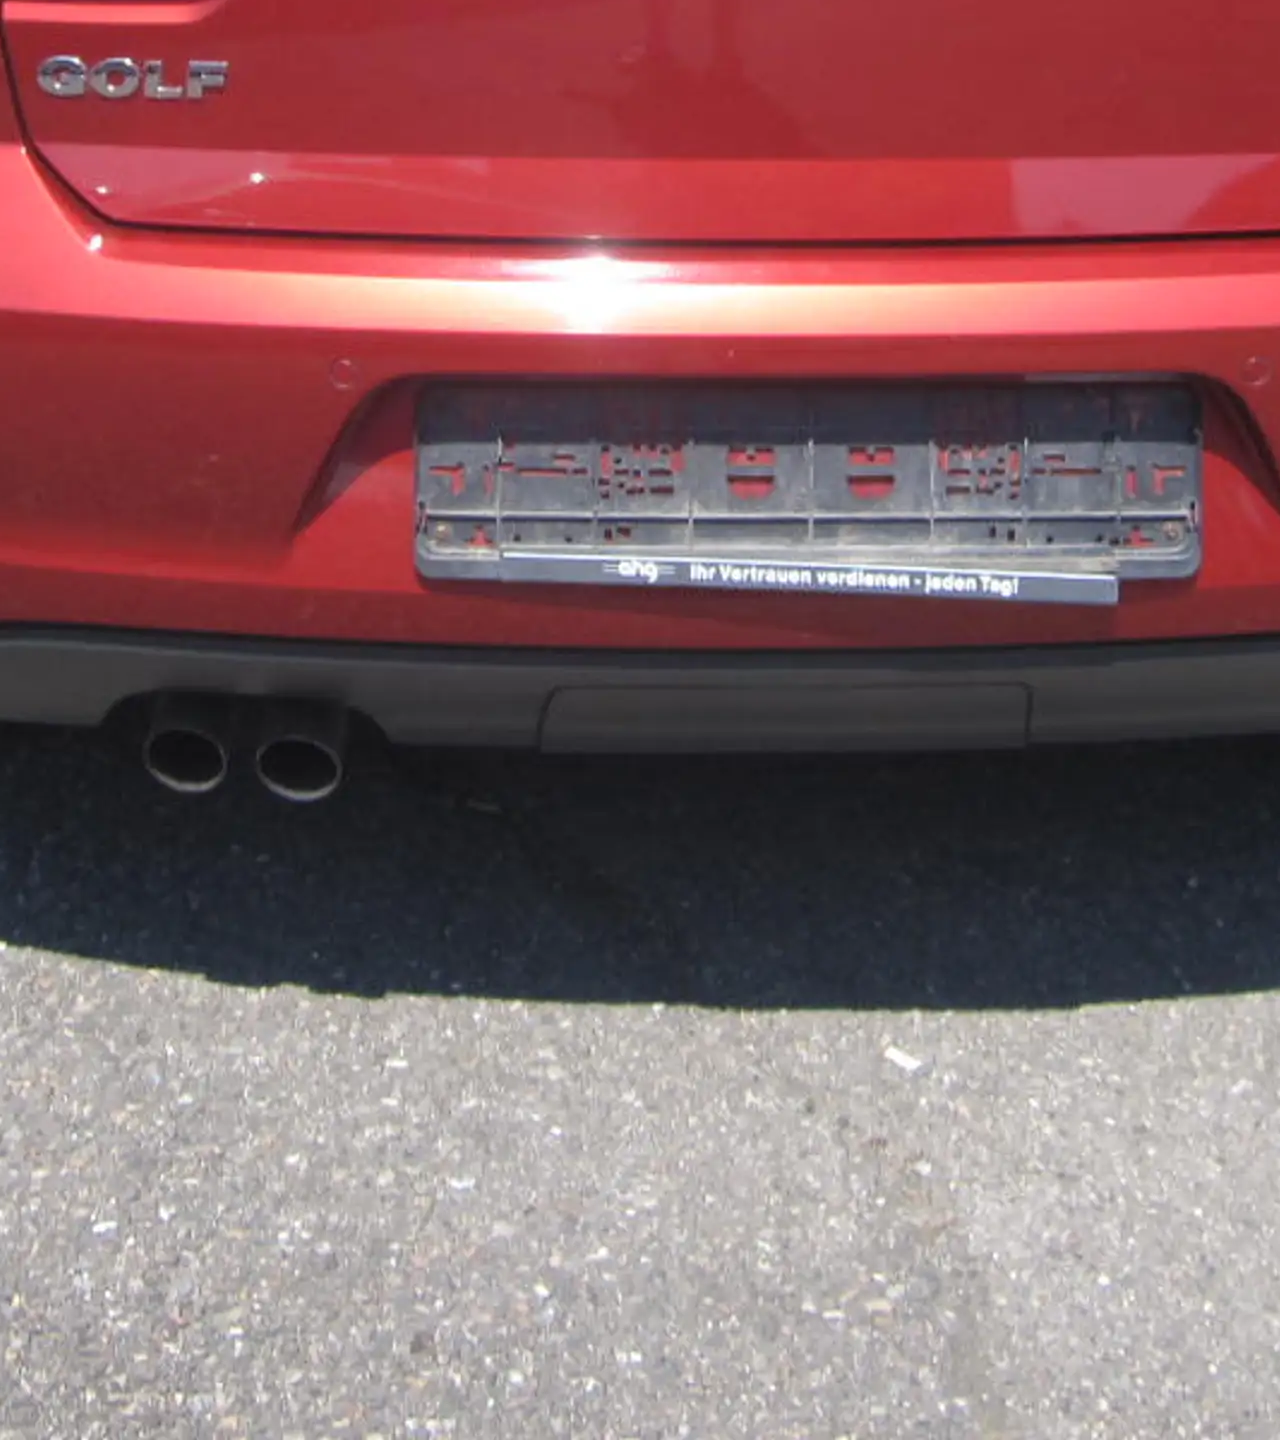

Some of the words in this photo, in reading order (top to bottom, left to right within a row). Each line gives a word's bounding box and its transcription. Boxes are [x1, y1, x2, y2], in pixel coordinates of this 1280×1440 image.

[36, 54, 230, 99] GOLF
[690, 563, 717, 581] Ihr
[720, 565, 812, 586] Vertrauen
[817, 568, 910, 590] verdienen
[925, 573, 977, 594] jeden
